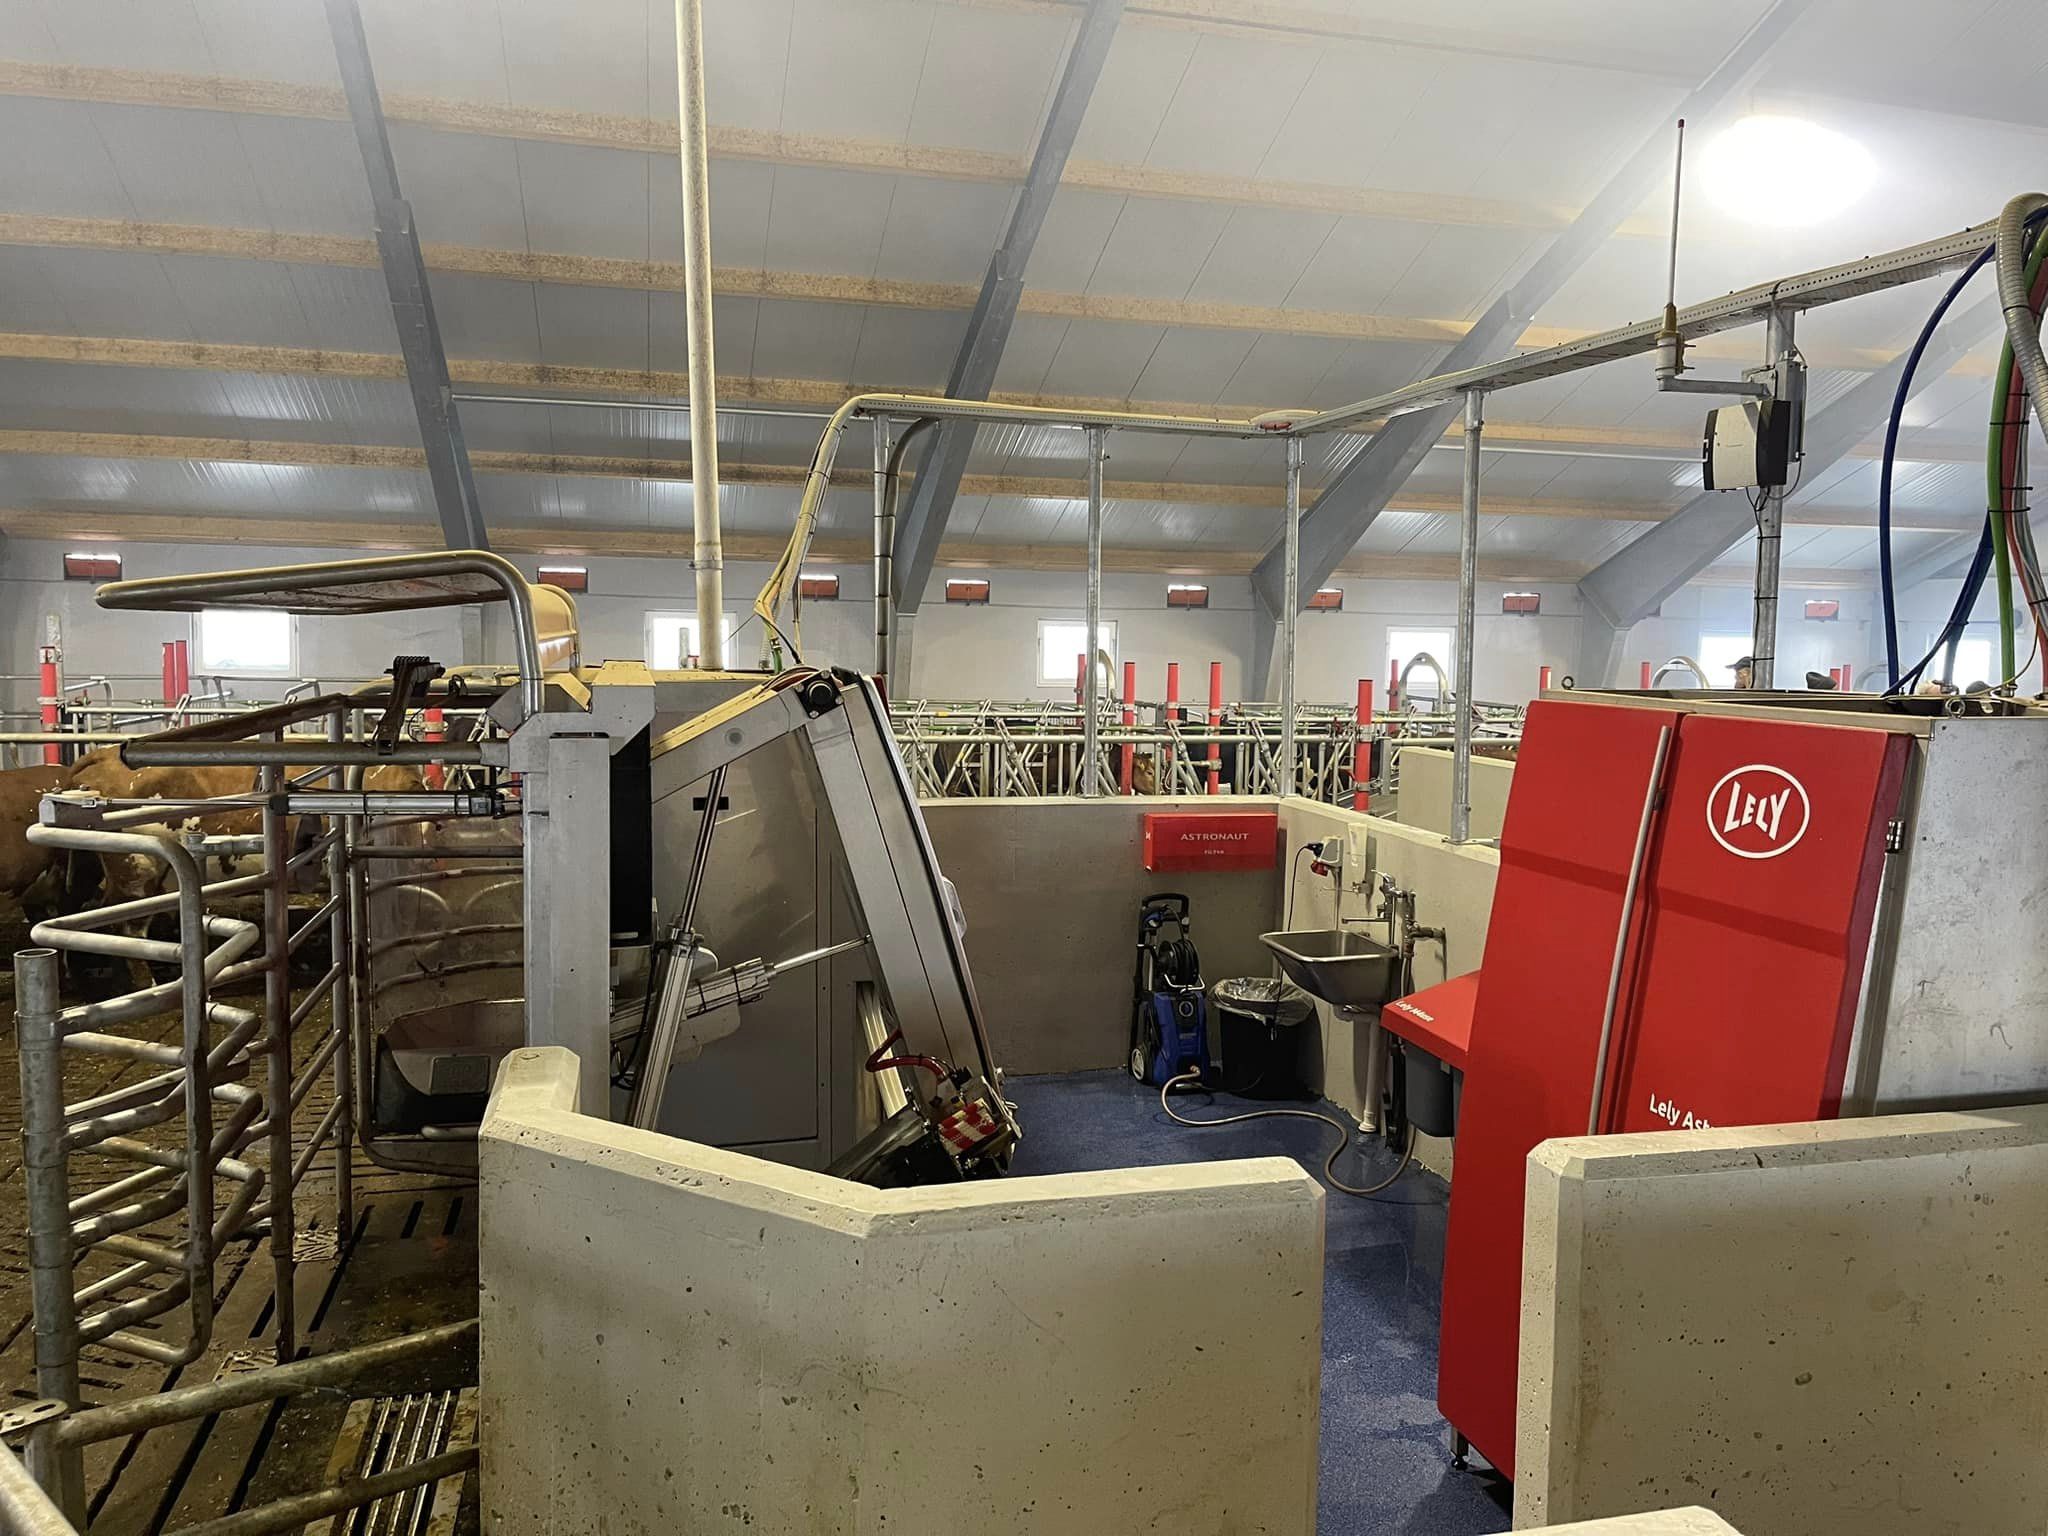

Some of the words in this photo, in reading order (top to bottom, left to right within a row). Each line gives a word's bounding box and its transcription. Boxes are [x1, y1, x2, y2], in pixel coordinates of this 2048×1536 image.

[1724, 781, 1791, 841] LELY
[1181, 833, 1249, 841] ASTRONAUT
[1395, 1001, 1413, 1011] Lely
[1650, 1093, 1680, 1126] Lely
